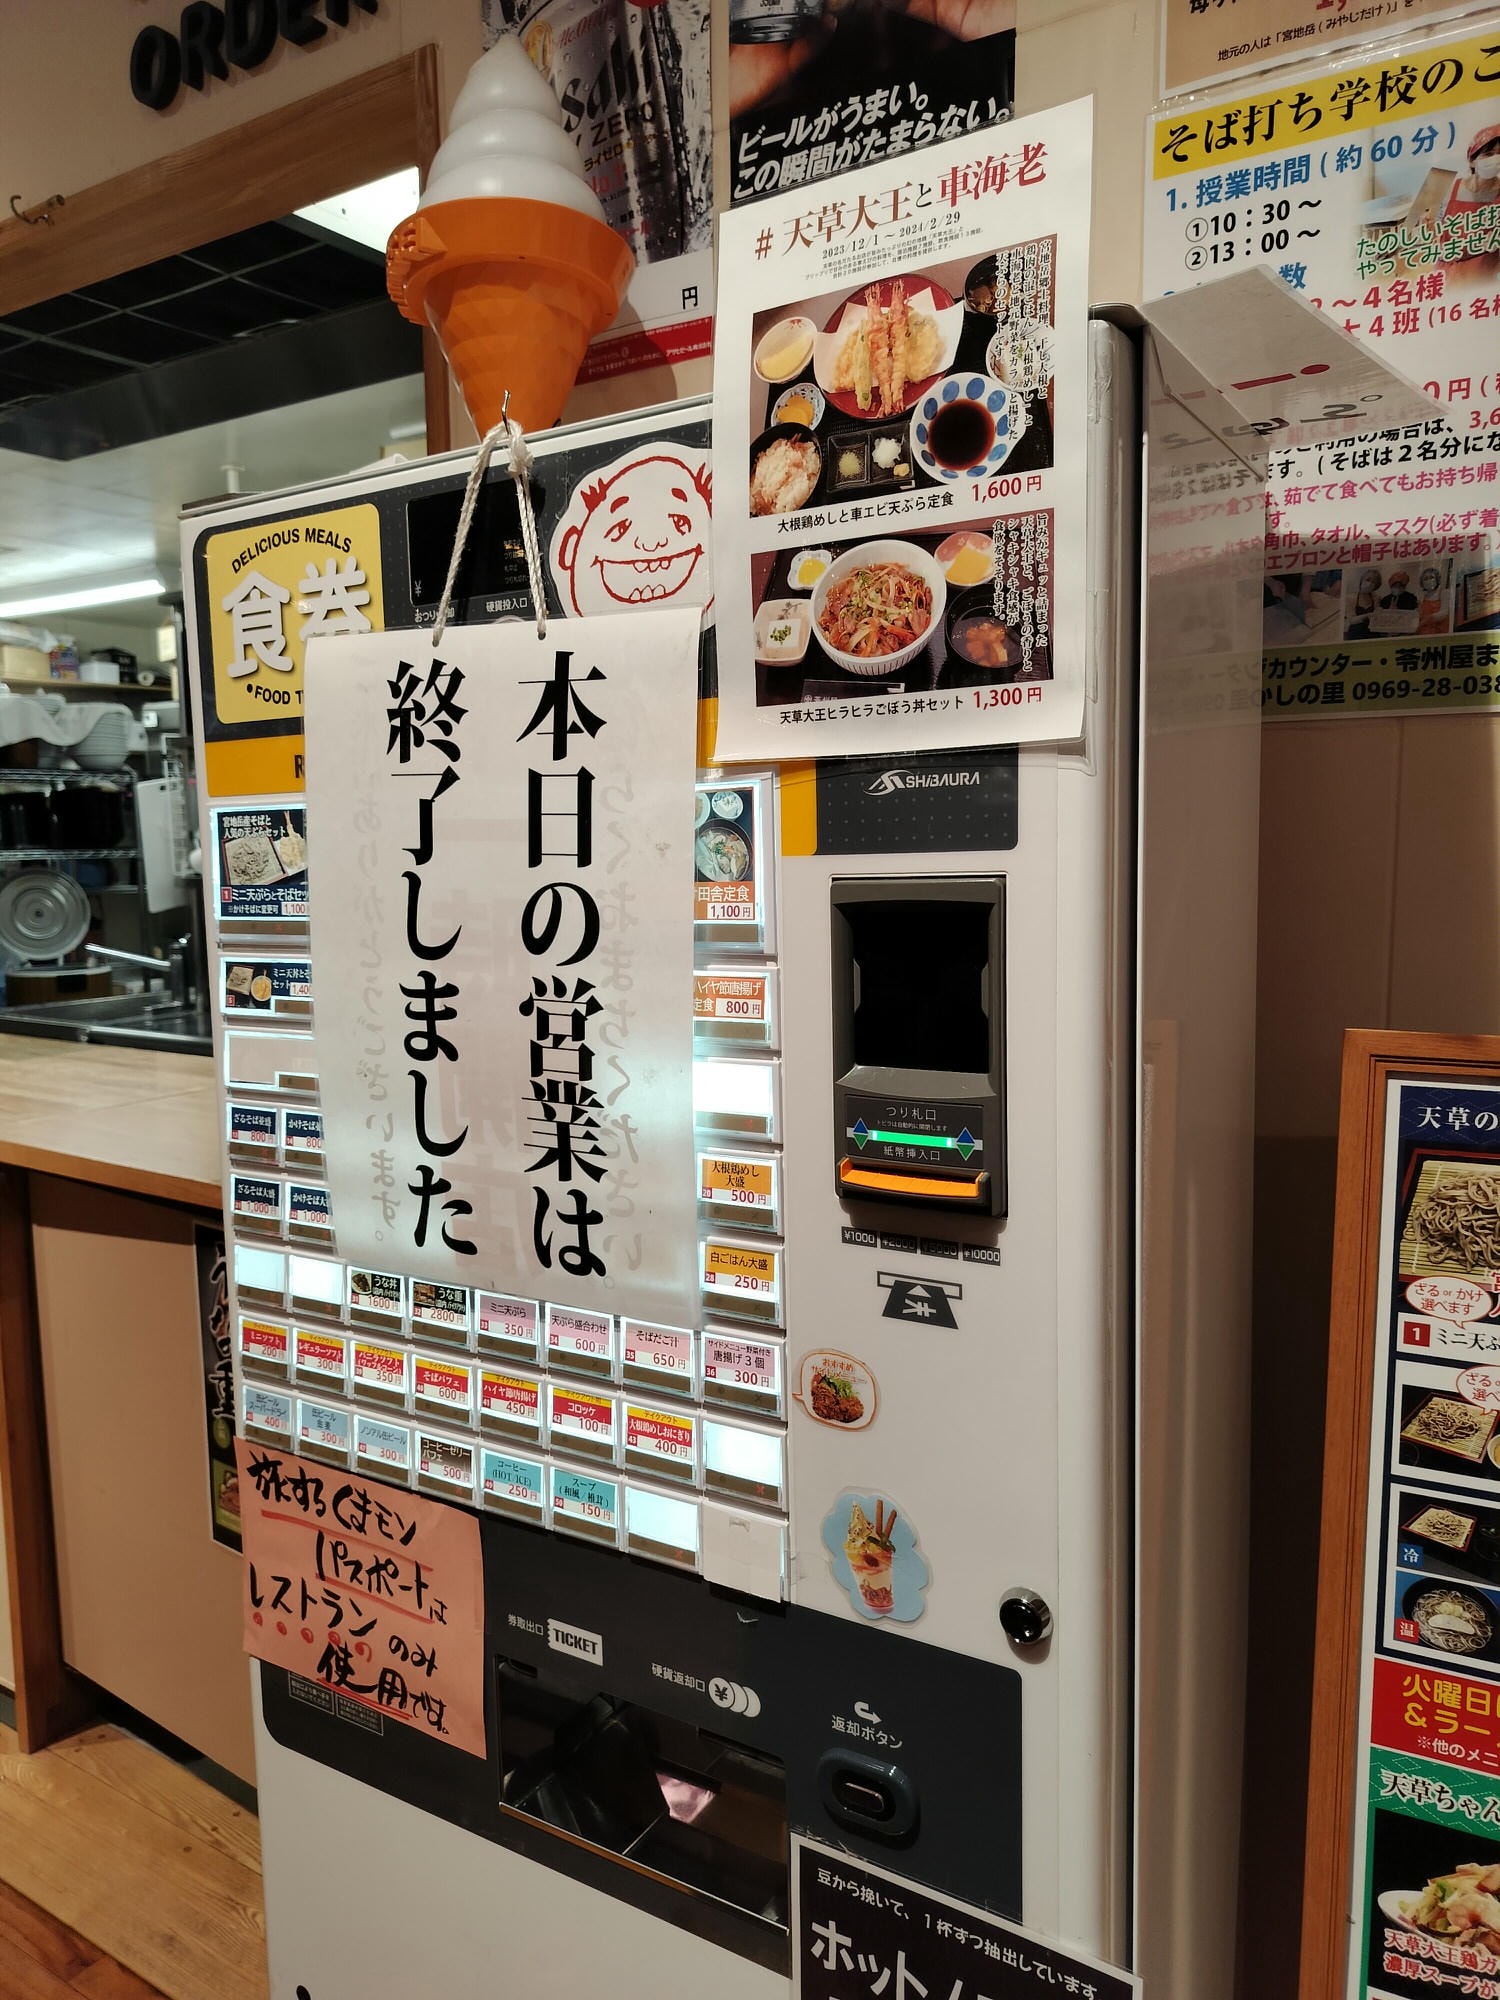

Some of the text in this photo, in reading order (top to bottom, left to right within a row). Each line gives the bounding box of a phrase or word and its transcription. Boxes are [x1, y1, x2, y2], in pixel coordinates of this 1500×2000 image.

[560, 25, 655, 132] sahi
[591, 101, 654, 147] ZERO
[738, 82, 929, 163] ビールがうまい。
[734, 97, 1011, 199] この瞬間がたまらない。
[782, 142, 1048, 257] 天草大王と車海老
[822, 211, 961, 259] 2023/12/1 2024/2/29
[682, 286, 698, 310] 円
[777, 475, 1043, 533] 大根鶏めしと車エビ天ぷら定食 1,600円
[231, 527, 352, 574] DELICIOUS MEALS
[993, 519, 1006, 621] 食欲をそそります。
[1007, 518, 1020, 627] シャキシャキ食感が
[486, 597, 528, 612] 硬貨投入口
[222, 556, 371, 678] 食券
[254, 685, 291, 705] FOOD
[780, 687, 1043, 724] 天草大王ヒラヒラごぼう丼セット 1,300円
[710, 904, 751, 919] 1,100円
[387, 658, 478, 1256] 終了しました
[516, 650, 608, 1278] 本日の営業は
[726, 1001, 760, 1015] 800円
[886, 1106, 937, 1121] つり札口
[884, 1145, 940, 1161] 紙幣挿入口
[712, 1161, 760, 1177] 大根鶏めし
[726, 1175, 745, 1188] 大盛
[703, 1188, 767, 1205] 20 500円
[710, 1252, 769, 1271] 白ごはん大盛
[374, 1276, 398, 1290] うな丼
[735, 1275, 770, 1292] 250円
[438, 1288, 463, 1301] うな重
[1414, 1284, 1443, 1298] ざる
[1455, 1287, 1484, 1302] かけ
[490, 1302, 526, 1318] ミニ天ぷら
[1421, 1297, 1475, 1315] 選べます
[505, 1322, 533, 1339] 350円
[551, 1314, 607, 1335] 天ぷら盛合わせ
[575, 1338, 606, 1355] 600円
[636, 1330, 680, 1348] そばだご汁
[708, 1340, 771, 1357] サイドメニュー野菜付き
[626, 1350, 686, 1370] 35 650円
[706, 1367, 769, 1388] 36 300円
[506, 1401, 535, 1417] 450円
[568, 1402, 596, 1417] コロッケ
[644, 1410, 677, 1424] テイクアウト
[579, 1416, 609, 1436] 100円
[422, 1438, 471, 1458] コーヒーゼリー
[422, 1451, 443, 1462] パフェ
[655, 1440, 688, 1457] 400円
[443, 1467, 470, 1482] 500円
[498, 1459, 527, 1472] コーヒー
[509, 1484, 537, 1501] 250円
[572, 1477, 596, 1491] スープ
[246, 1450, 417, 1547] 旅するくまモン
[581, 1502, 611, 1521] 150円
[1404, 1548, 1419, 1563] 冷
[316, 1529, 448, 1626] パスポートは
[249, 1563, 439, 1677] レストラン のみ
[1400, 1620, 1414, 1638] 温
[508, 1613, 599, 1656] 券取出口 TICKET
[651, 1662, 706, 1693] 硬貨返却口
[316, 1641, 450, 1735] 使用です。
[831, 1714, 903, 1750] 返却ボタン
[1383, 1952, 1497, 1999] 濃厚スープが
